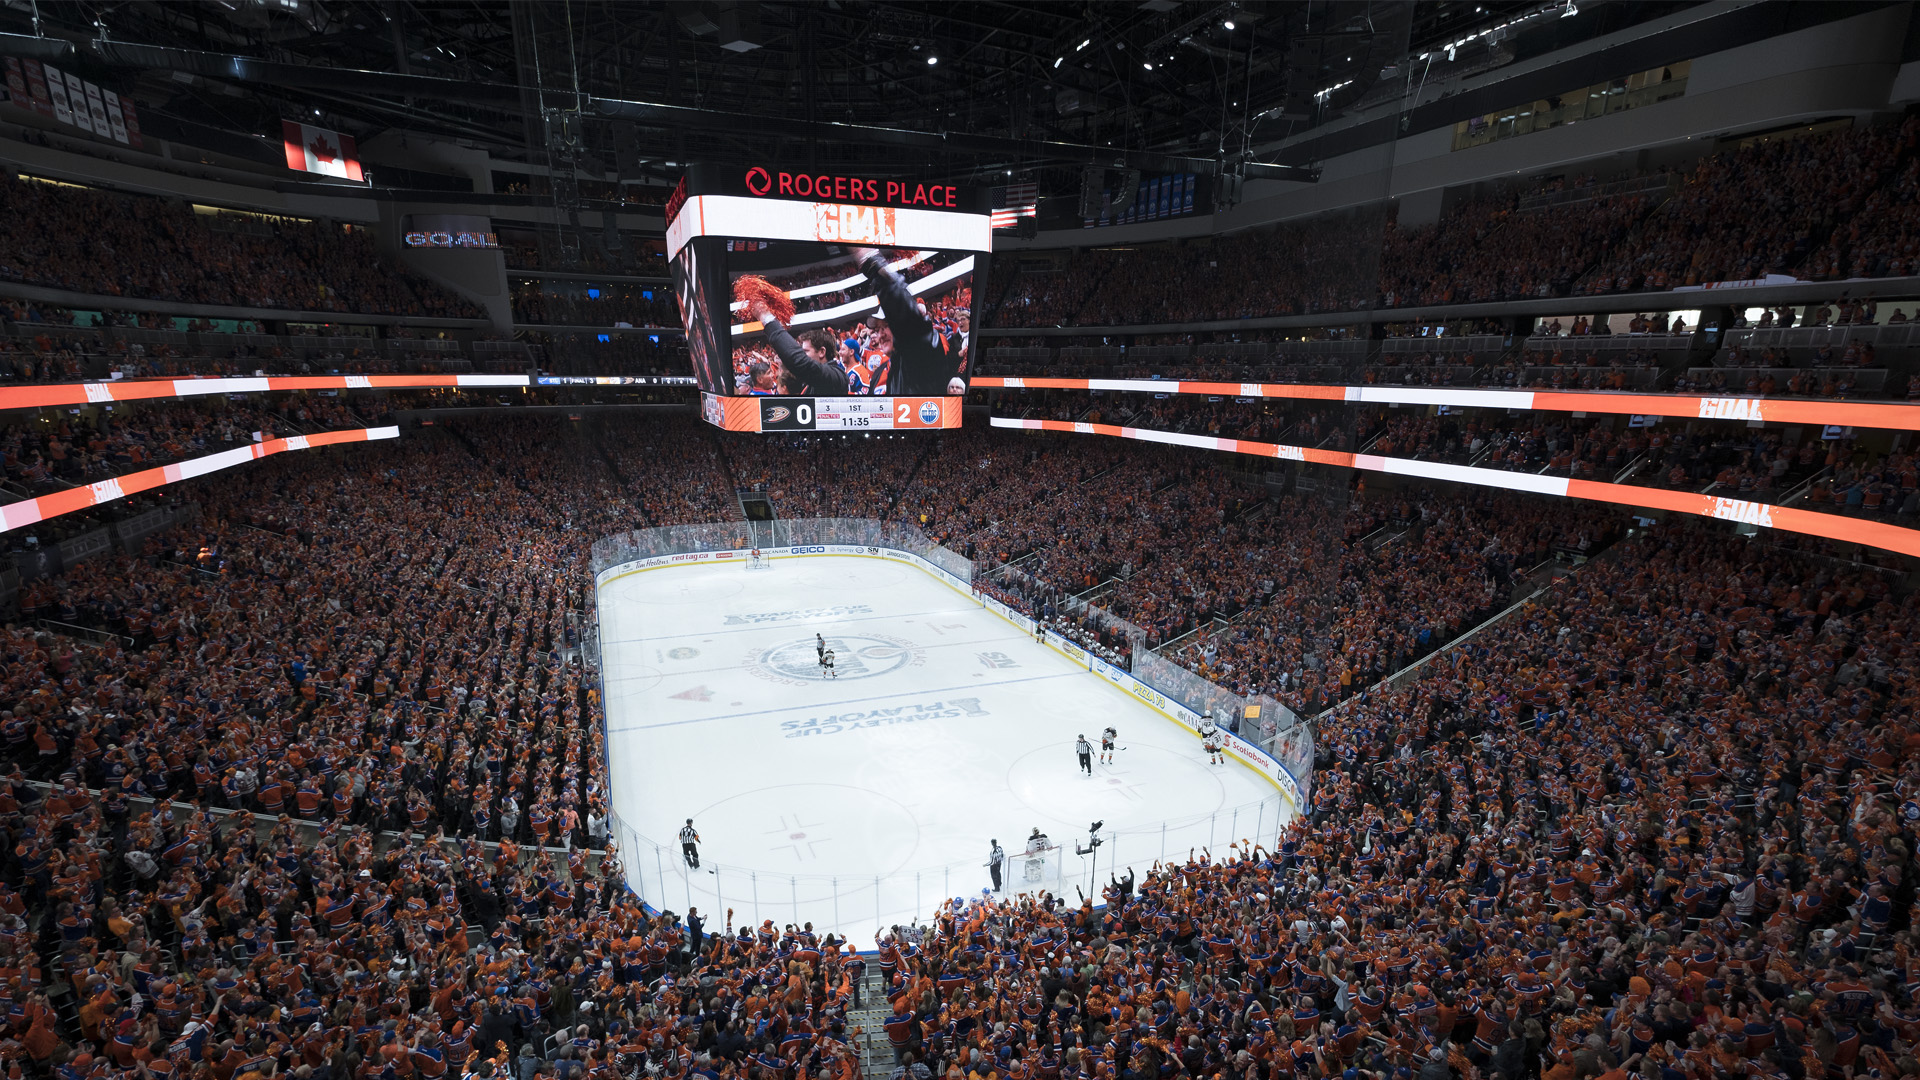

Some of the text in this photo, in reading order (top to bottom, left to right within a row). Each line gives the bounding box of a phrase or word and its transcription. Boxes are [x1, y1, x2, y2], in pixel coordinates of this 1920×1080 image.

[778, 172, 957, 207] ROGERS PLACE
[816, 202, 896, 245] GOAL
[1003, 377, 1026, 388] GOAL
[1240, 383, 1264, 396] GOAL
[796, 404, 812, 425] 0
[879, 404, 884, 412] 5
[897, 404, 911, 423] 2
[1698, 397, 1763, 421] GOAL
[842, 418, 869, 427] 11:35
[1277, 444, 1305, 461] GOAL
[1714, 496, 1774, 528] GOAL
[791, 546, 825, 554] GEICO
[635, 561, 646, 569] Tim
[1111, 668, 1123, 681] SAP
[1133, 681, 1166, 709] PIZZA 73
[780, 701, 946, 732] PLAYOFFS
[849, 708, 961, 731] STANLEY
[1232, 741, 1270, 769] Scotiabank
[1843, 992, 1867, 1000] MESSIER
[1843, 999, 1861, 1015] 11
